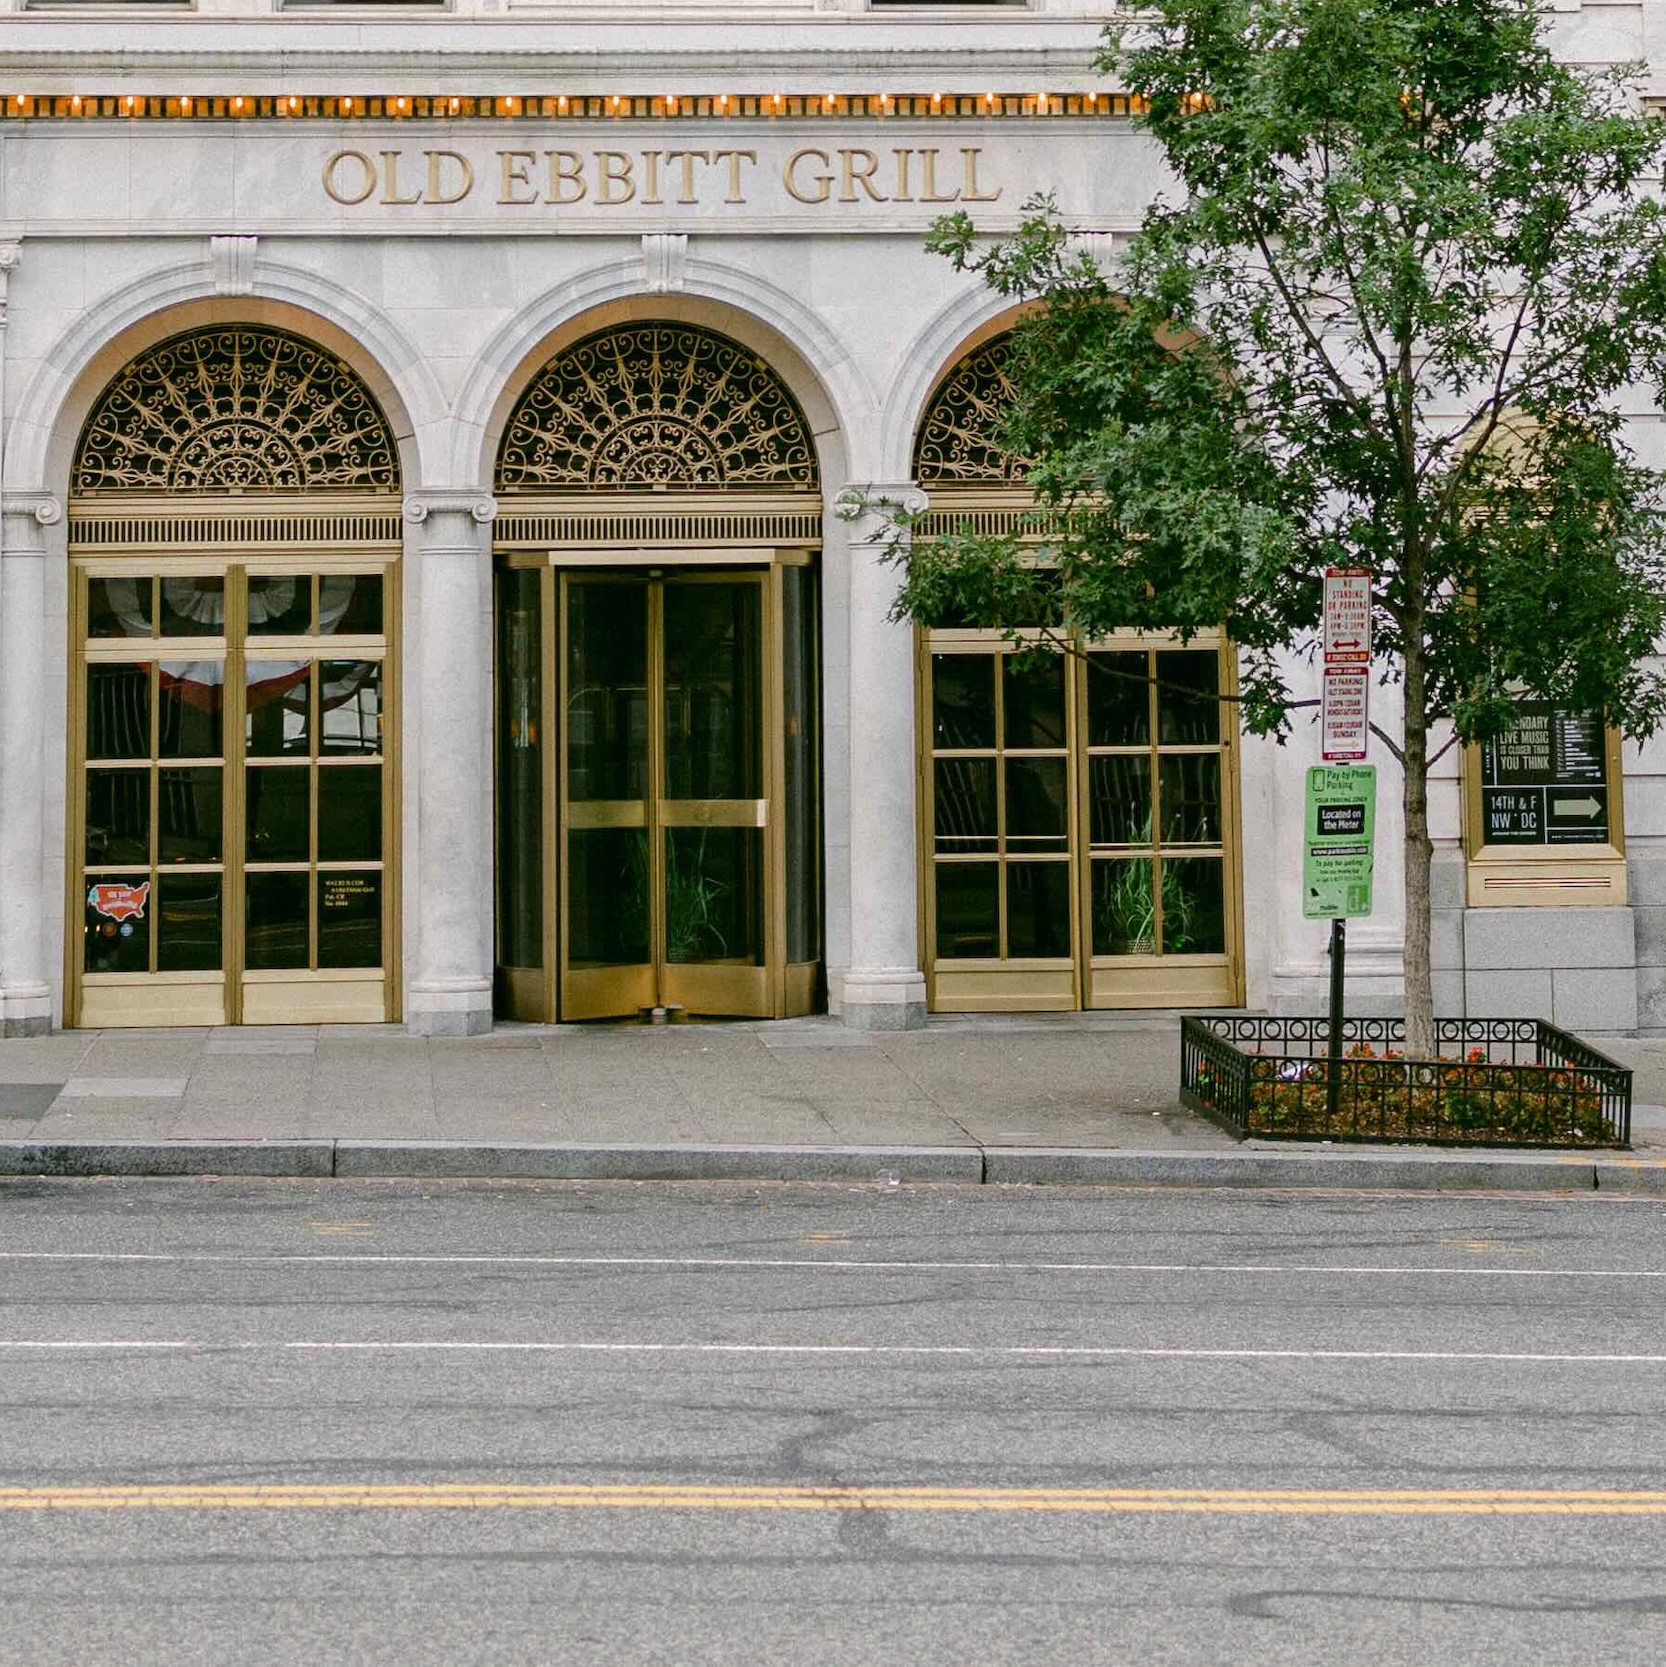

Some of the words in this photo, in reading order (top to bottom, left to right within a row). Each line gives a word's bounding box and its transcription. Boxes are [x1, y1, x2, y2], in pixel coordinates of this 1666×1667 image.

[321, 149, 474, 206] OLD
[496, 149, 757, 205] EBBITT
[782, 148, 1004, 204] GRILL
[1332, 590, 1364, 599] STANDING
[1340, 601, 1367, 610] PARKING
[1333, 730, 1357, 738] SUNDAY
[1499, 731, 1519, 744] LIVE
[1521, 731, 1549, 744] MUSIC
[1507, 745, 1531, 754] CLOSER
[1533, 744, 1550, 754] THAN
[1500, 756, 1520, 770] YOU
[1523, 755, 1550, 769] THINK
[1327, 771, 1339, 781] Pay
[1342, 770, 1350, 780] by
[1352, 769, 1372, 779] Phone
[1326, 781, 1353, 791] Parking
[1491, 796, 1515, 810] 14TH
[1519, 797, 1527, 810] &
[1531, 795, 1537, 809] F
[1322, 809, 1351, 819] Located
[1323, 820, 1337, 829] the
[1338, 819, 1359, 829] Meter
[1491, 812, 1511, 828] NW
[1521, 812, 1537, 828] DC
